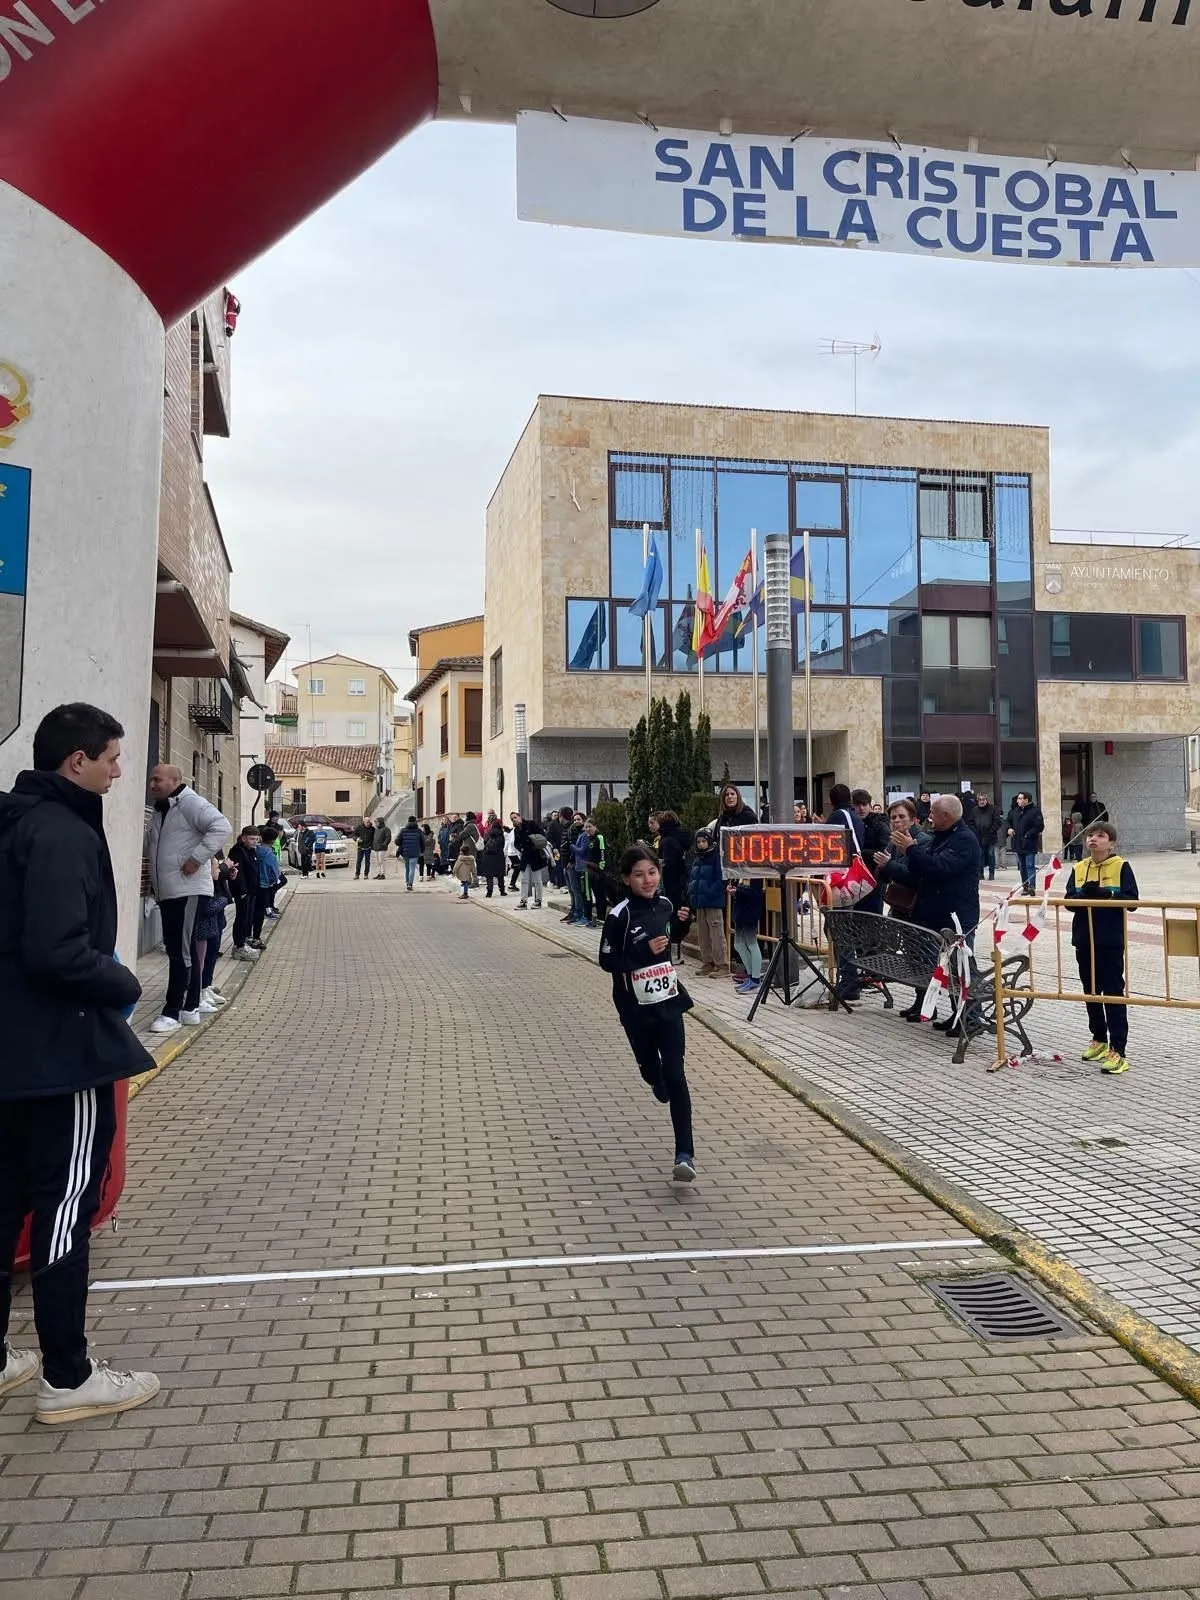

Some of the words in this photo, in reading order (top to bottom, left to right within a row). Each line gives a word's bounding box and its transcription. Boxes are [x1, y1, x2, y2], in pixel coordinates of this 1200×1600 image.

[654, 138, 795, 192] SAN
[822, 149, 1178, 220] CRISTOBAL
[682, 187, 767, 237] DE
[796, 195, 880, 244] LA
[906, 206, 1155, 263] CUESTA
[1070, 566, 1169, 581] AYUNTAMIENTO
[644, 976, 670, 994] 438
